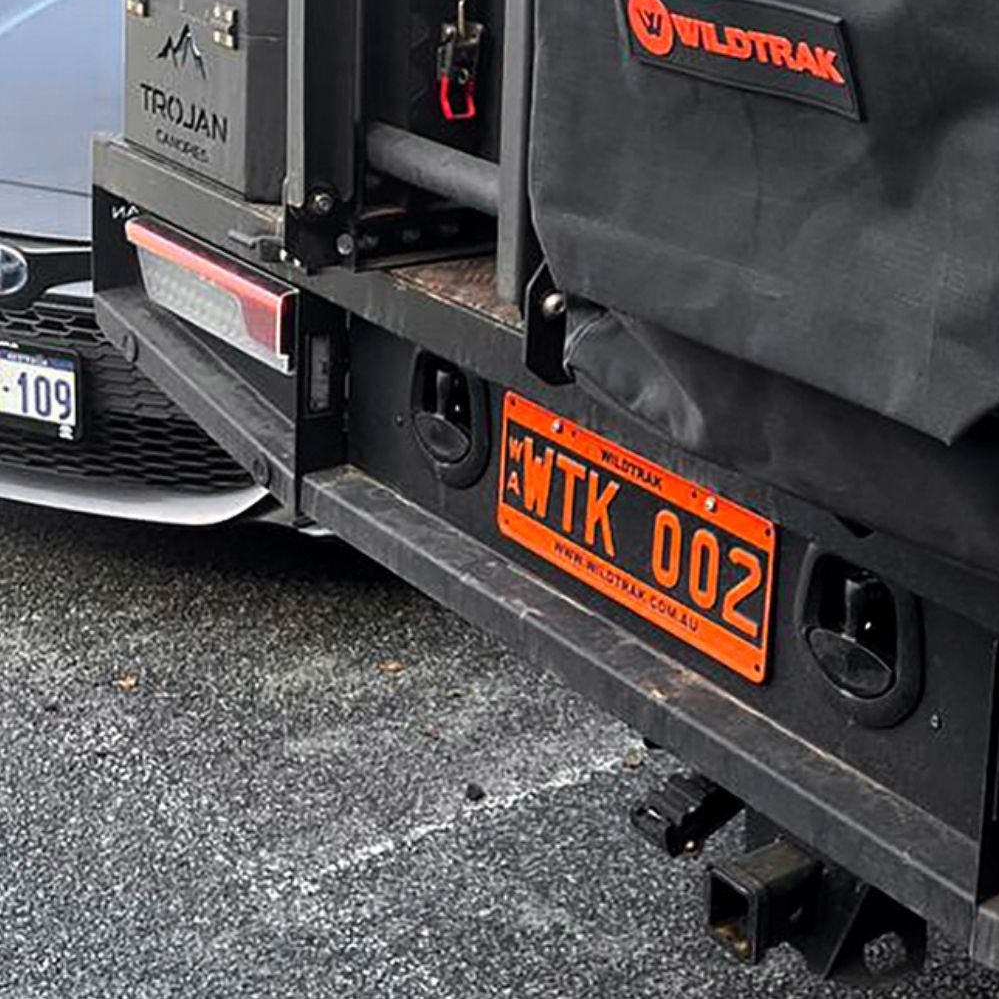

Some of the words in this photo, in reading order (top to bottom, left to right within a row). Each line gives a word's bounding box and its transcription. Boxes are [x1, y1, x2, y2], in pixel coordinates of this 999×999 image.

[670, 12, 846, 85] WILDTRAK
[140, 83, 228, 143] TROJAN
[599, 450, 664, 492] WILDTRAK
[523, 435, 621, 559] WTK
[651, 509, 762, 638] 002
